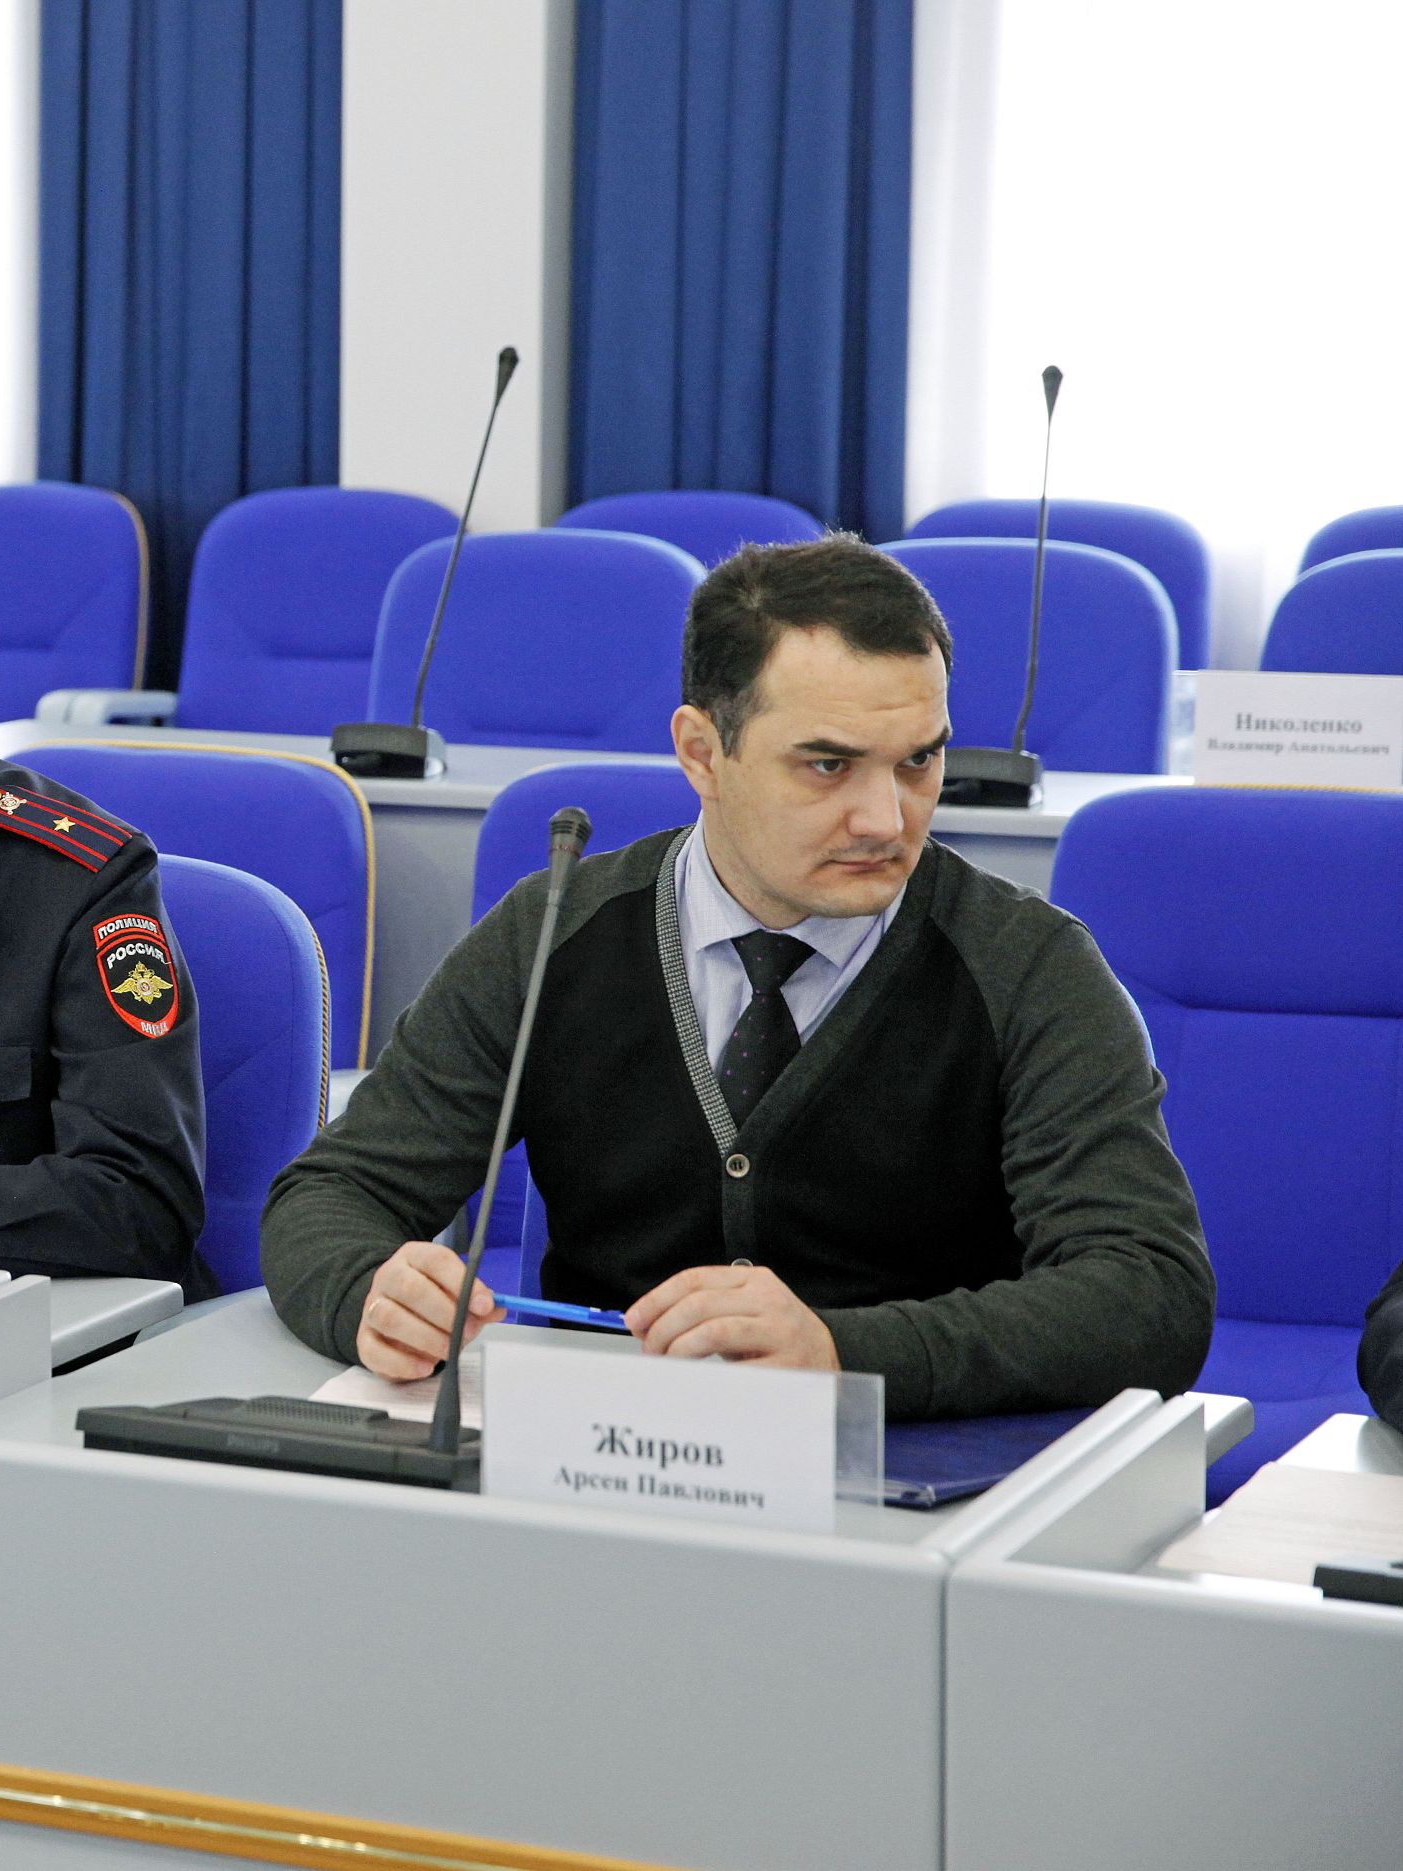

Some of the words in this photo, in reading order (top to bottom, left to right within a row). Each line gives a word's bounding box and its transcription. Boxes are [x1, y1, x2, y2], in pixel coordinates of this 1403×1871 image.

[1235, 713, 1363, 734] Николенко
[98, 918, 158, 939] ПОЛИЦИЯ
[107, 943, 165, 969] РОССИЯ
[592, 1423, 725, 1469] Жиров
[553, 1465, 628, 1492] Арсен
[638, 1473, 765, 1509] Павлович
